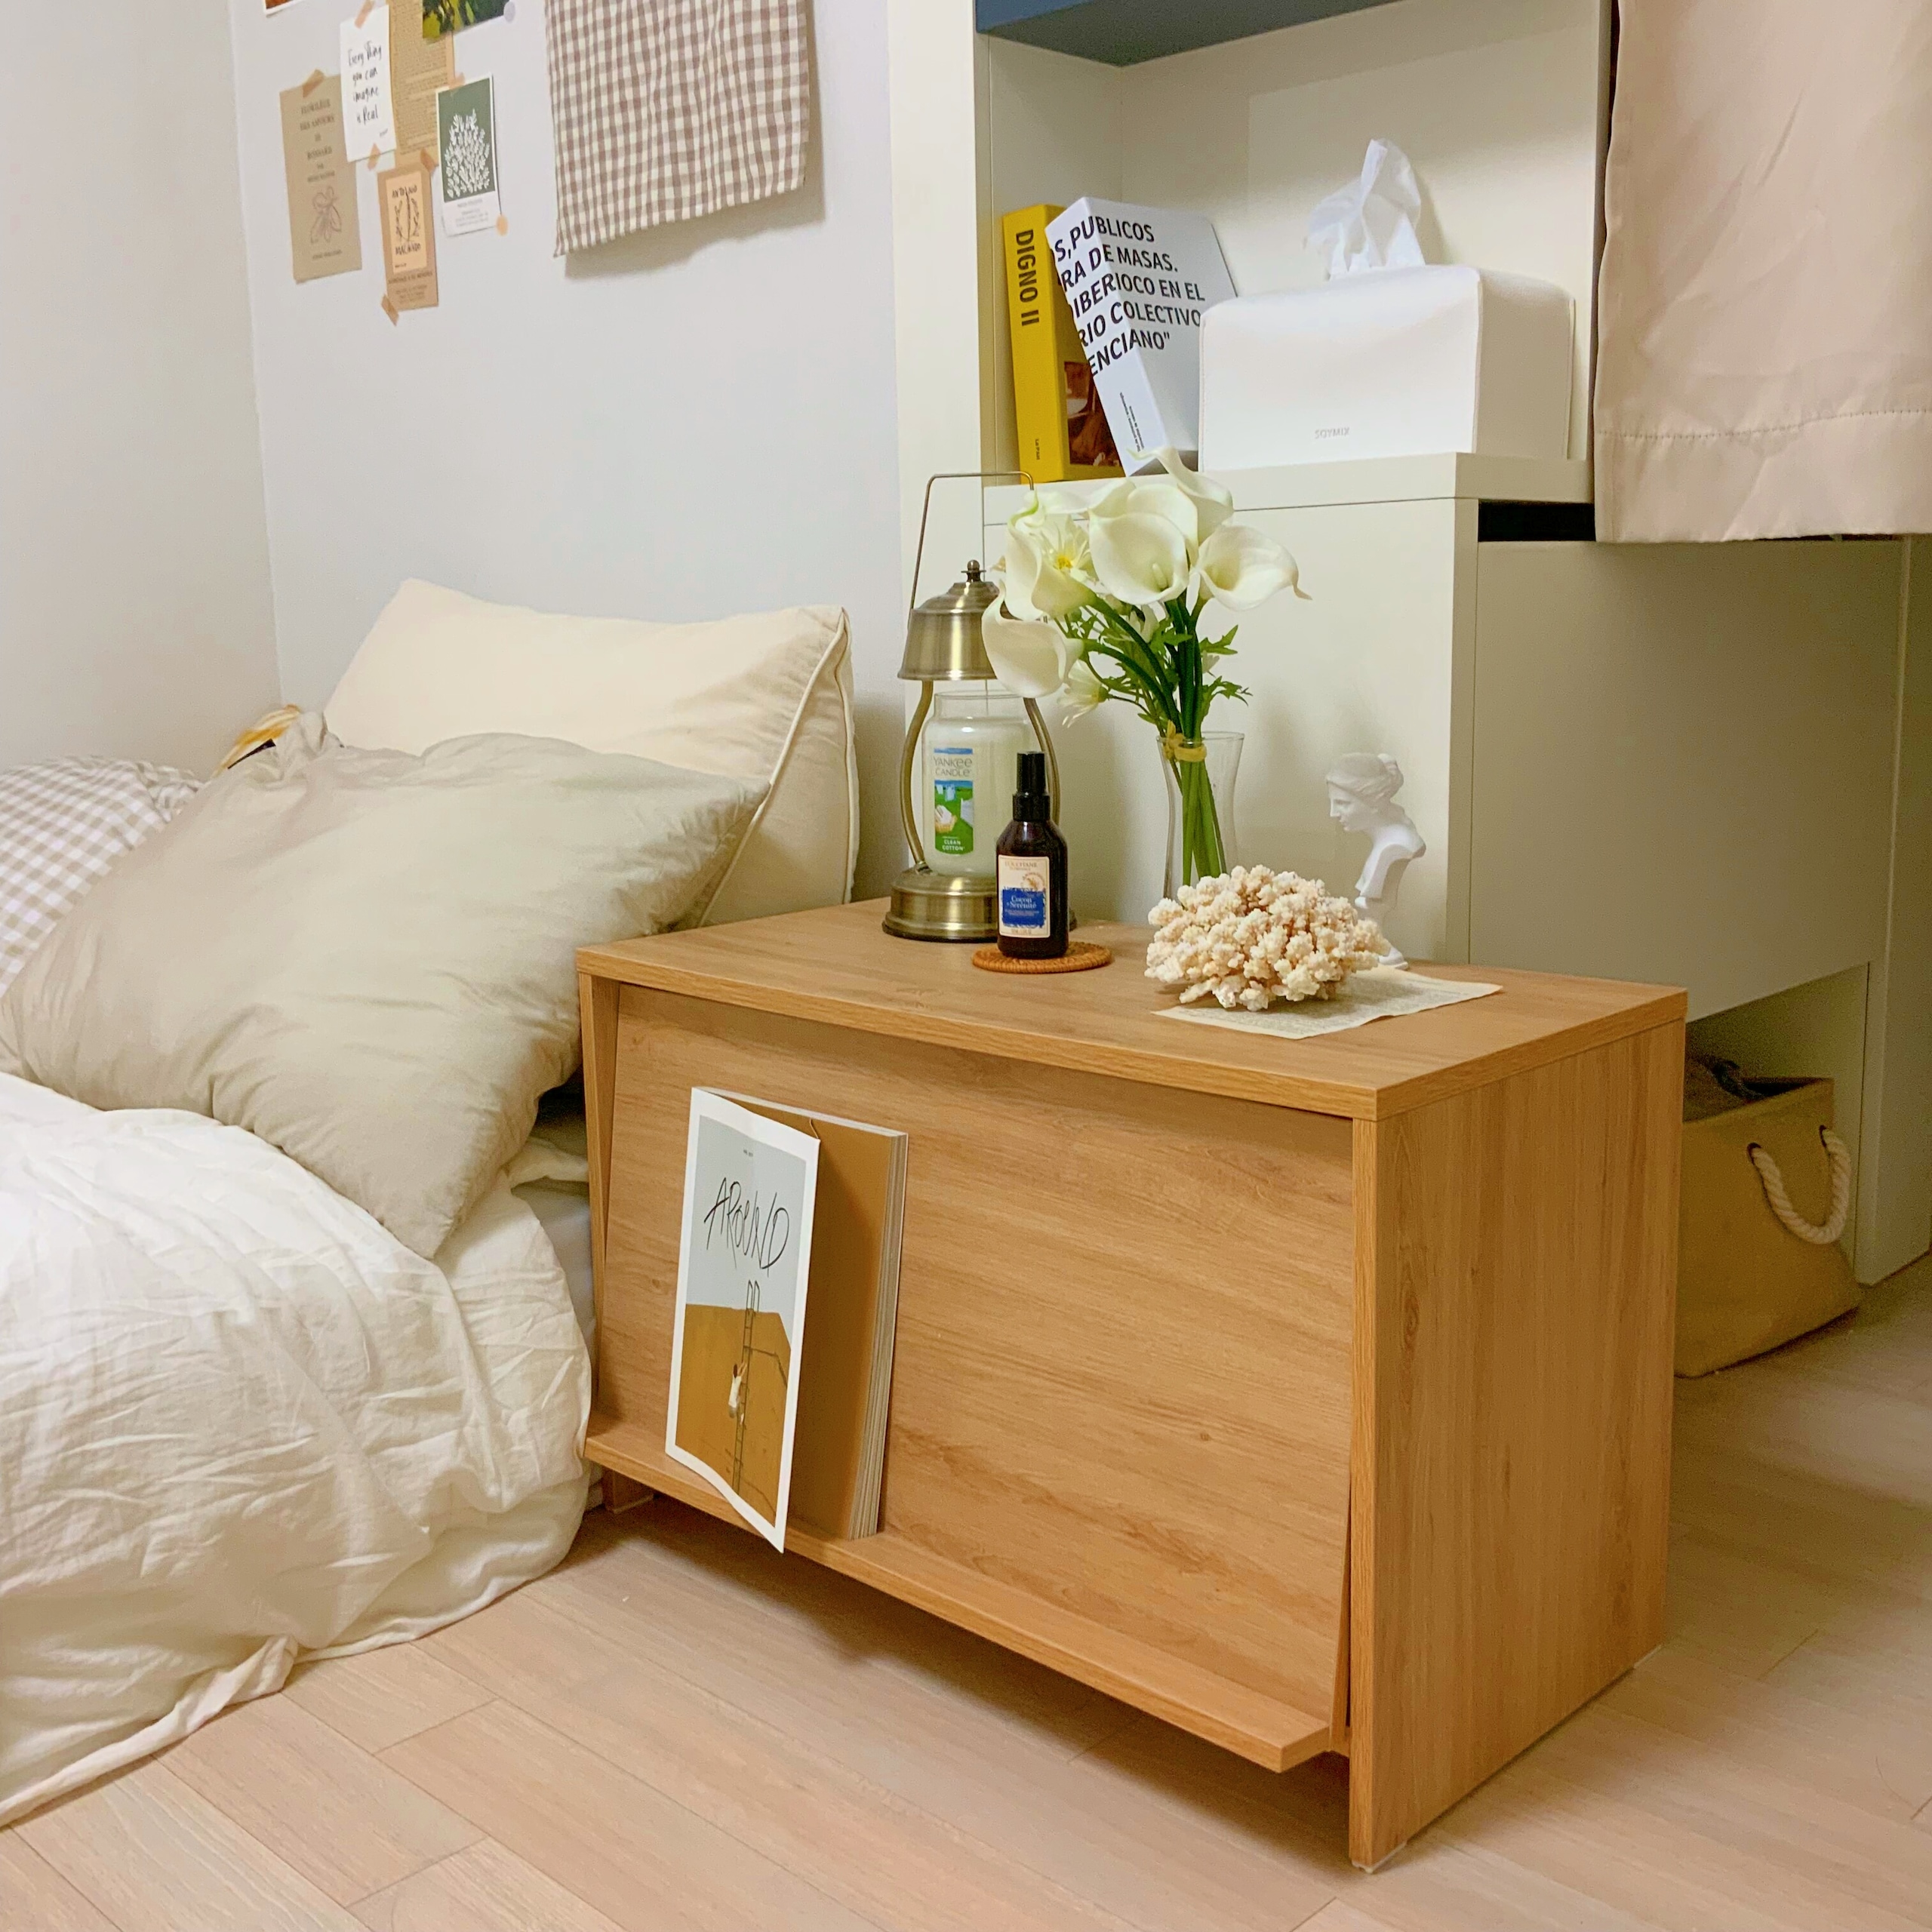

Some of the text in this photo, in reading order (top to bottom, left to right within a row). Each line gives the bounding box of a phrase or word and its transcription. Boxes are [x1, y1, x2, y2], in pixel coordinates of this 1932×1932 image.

[1016, 229, 1038, 303] DIGNO
[1088, 244, 1115, 272] DE
[1116, 246, 1178, 272] MASAS.
[1158, 279, 1182, 300] EN
[1184, 282, 1206, 301] EL
[1110, 300, 1201, 328] COLECTIVO
[704, 1177, 789, 1278] AROUND
